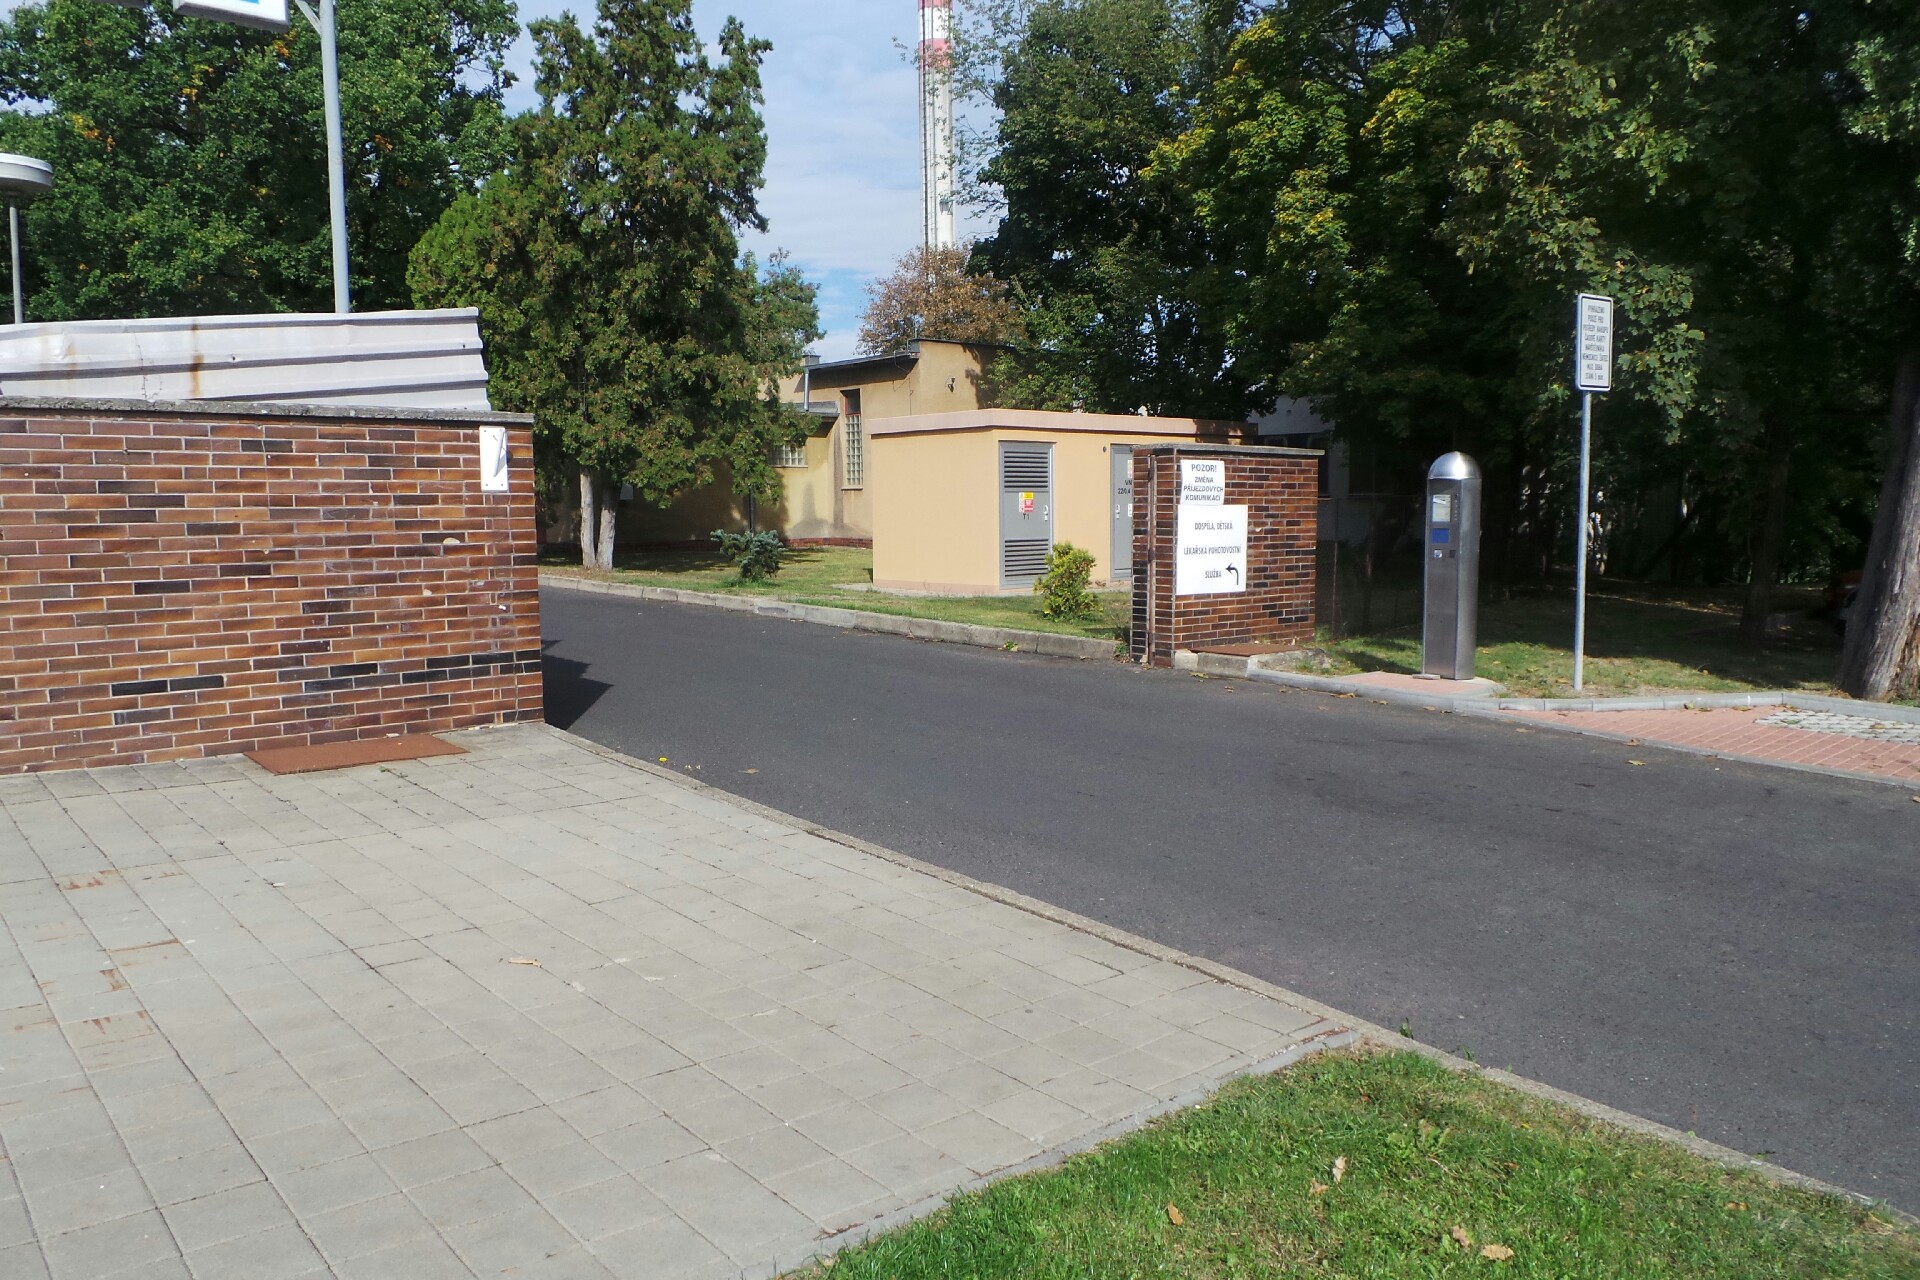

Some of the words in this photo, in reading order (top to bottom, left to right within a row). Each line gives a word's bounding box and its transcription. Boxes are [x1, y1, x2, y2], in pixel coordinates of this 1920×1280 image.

[1191, 463, 1217, 473] POZOR!
[1194, 474, 1214, 484] ZMĚNA
[1204, 568, 1222, 579] SLUŽBA
